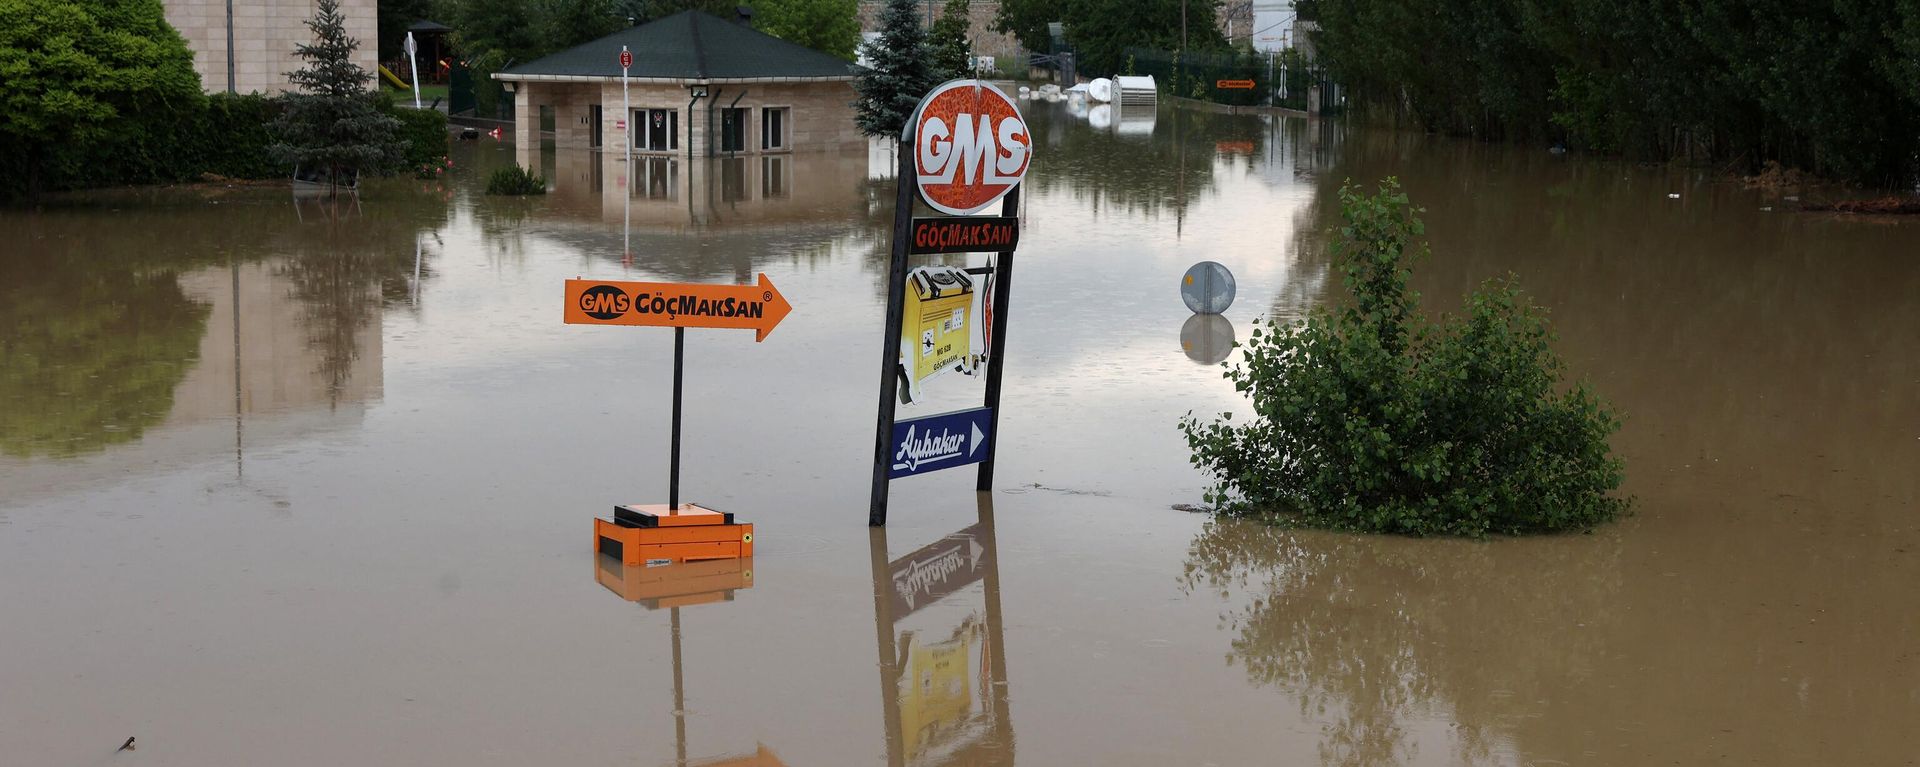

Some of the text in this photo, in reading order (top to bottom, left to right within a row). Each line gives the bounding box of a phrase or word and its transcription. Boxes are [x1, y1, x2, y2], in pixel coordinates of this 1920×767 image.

[920, 113, 1026, 185] GMS
[581, 292, 630, 315] GMS
[895, 424, 965, 471] Aybakar
